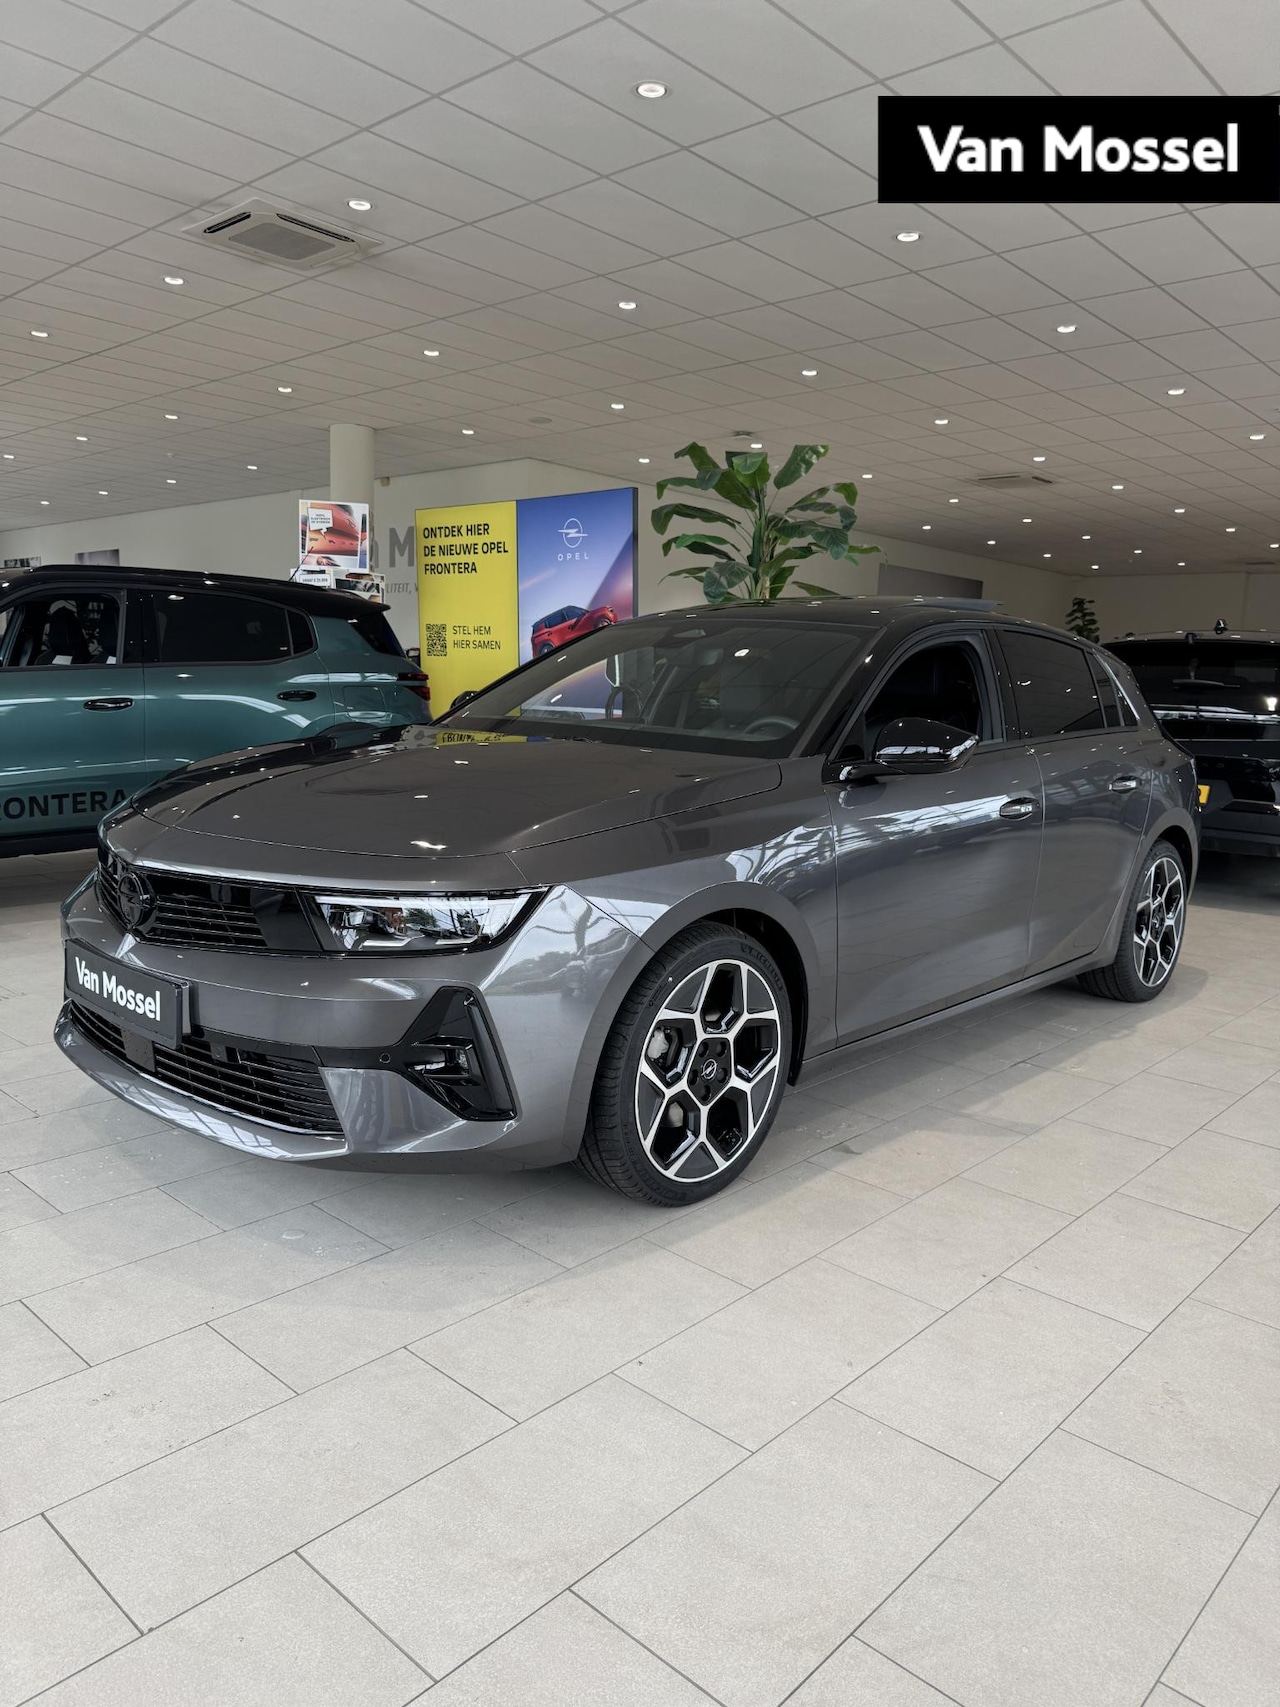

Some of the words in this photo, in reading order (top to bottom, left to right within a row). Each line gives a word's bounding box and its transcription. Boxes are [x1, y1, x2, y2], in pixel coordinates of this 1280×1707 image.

[423, 525, 463, 539] ONTDEK
[466, 523, 490, 536] HIER
[423, 545, 436, 557] DE
[438, 543, 479, 557] NIEUWE
[481, 541, 509, 554] OPEL
[557, 552, 590, 562] OPEL
[424, 562, 478, 575] FRONTERA
[385, 583, 412, 595] LITEIT,
[452, 625, 472, 635] STEL
[473, 625, 492, 636] HEM
[453, 640, 471, 649] HIER
[472, 640, 501, 650] SAMEN
[0, 788, 127, 821] ONTERA
[74, 956, 100, 995] Van
[102, 970, 161, 1022] Mossel
